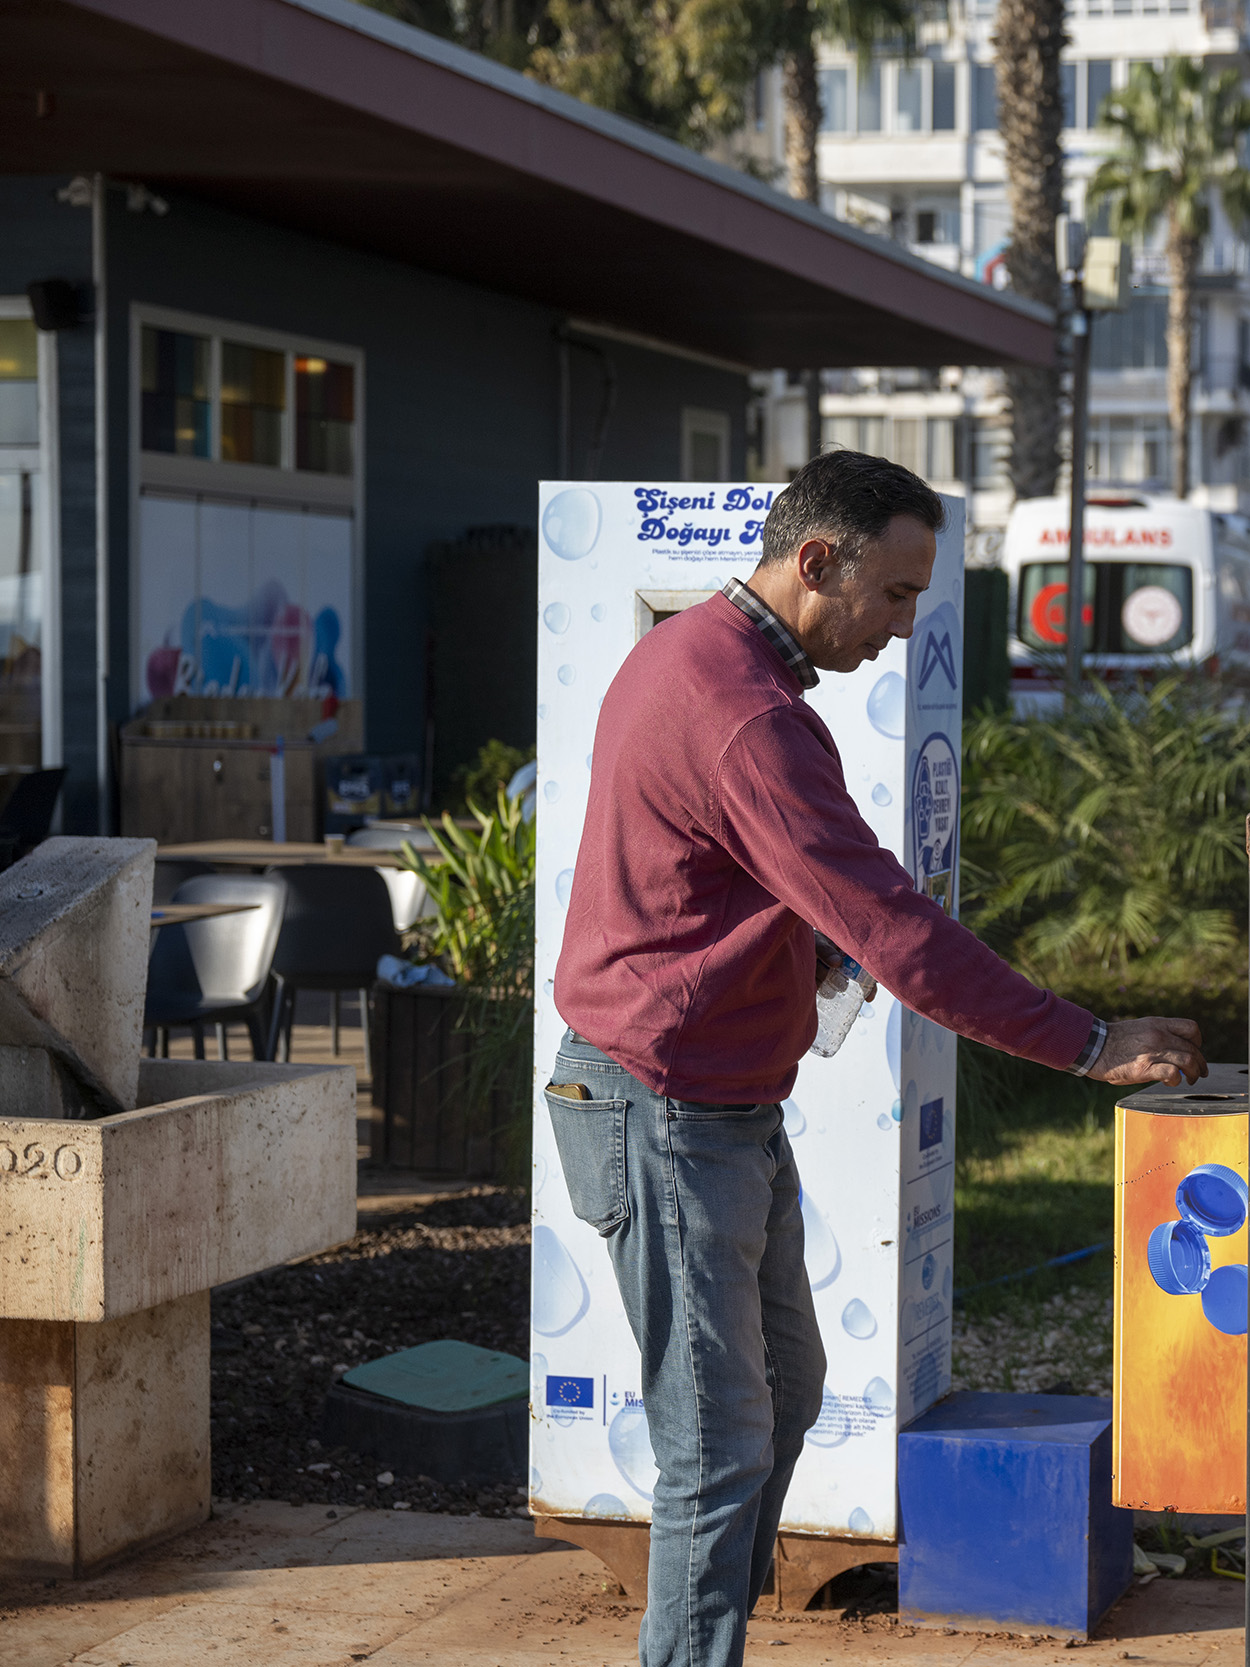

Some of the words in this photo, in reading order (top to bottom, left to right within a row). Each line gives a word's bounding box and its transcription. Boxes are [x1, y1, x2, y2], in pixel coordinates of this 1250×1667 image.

[634, 487, 716, 518] Şişeni
[637, 515, 732, 546] Doğayı
[1039, 528, 1173, 547] AMULANS
